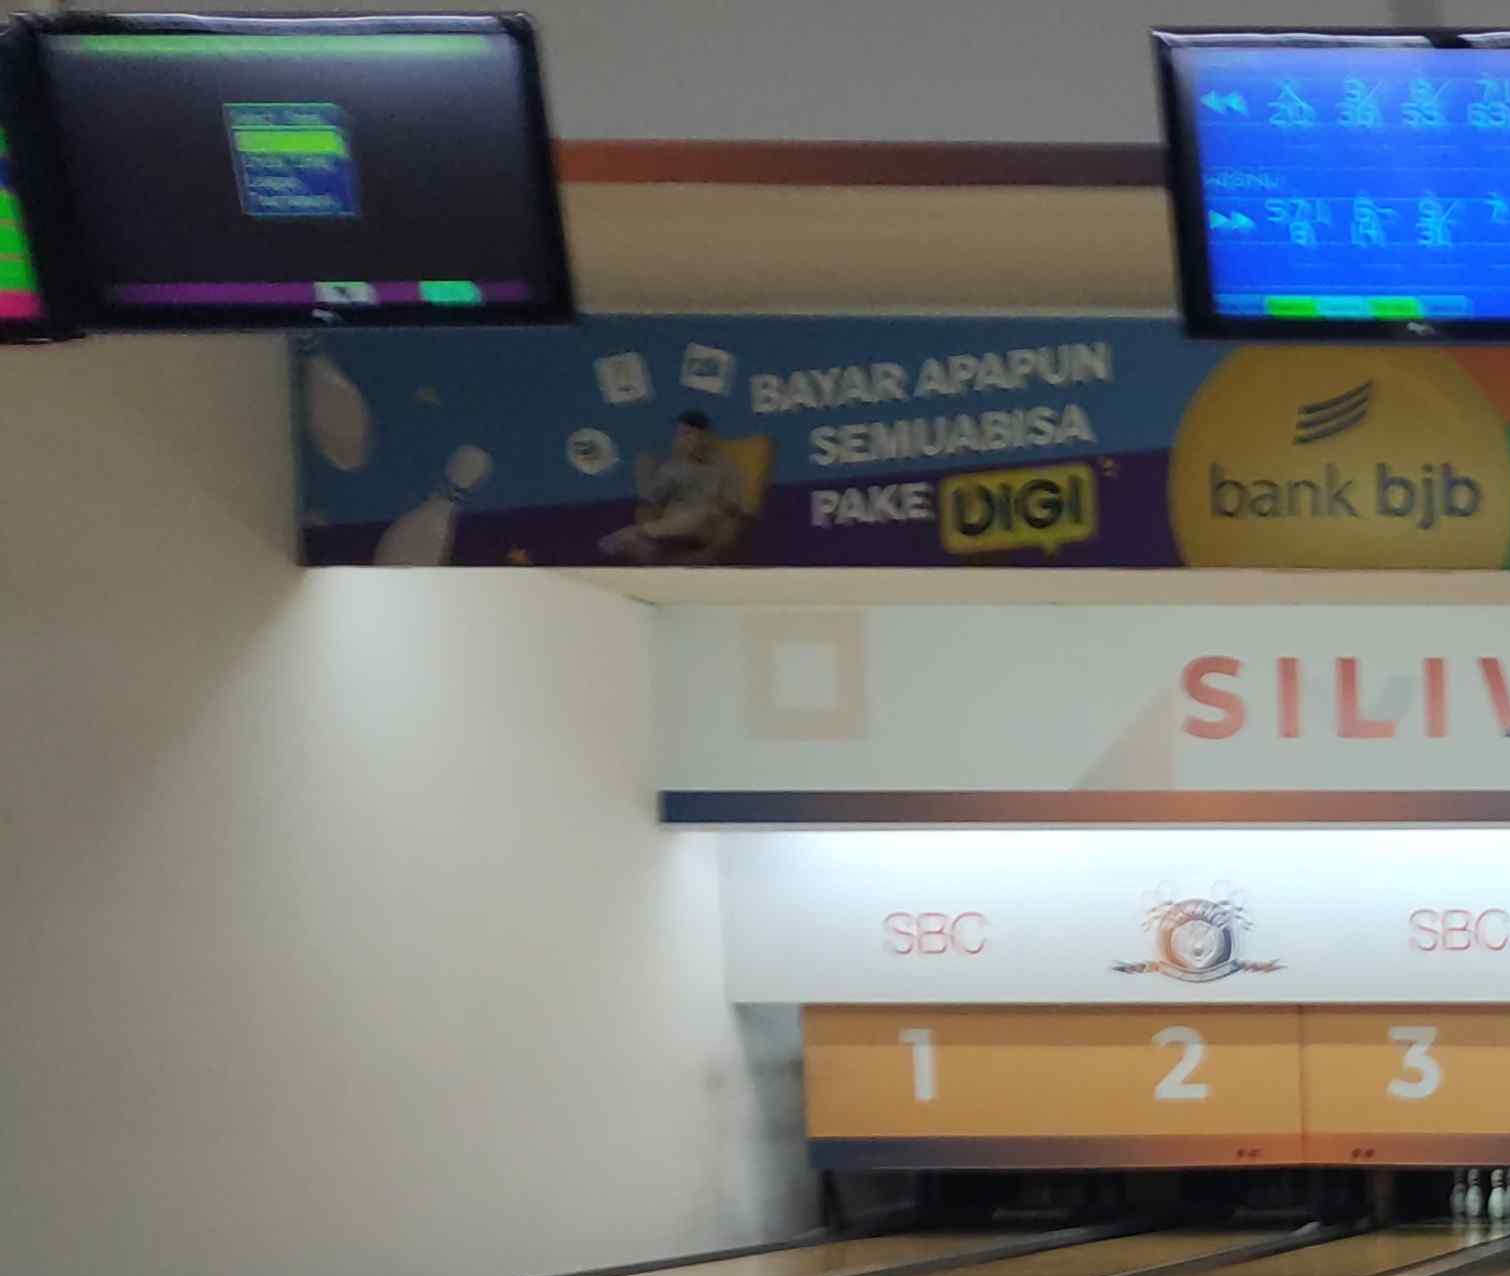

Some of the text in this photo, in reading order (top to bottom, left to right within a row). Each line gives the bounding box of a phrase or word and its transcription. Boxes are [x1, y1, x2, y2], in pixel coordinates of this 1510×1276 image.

[750, 342, 1114, 414] BAYAR APAPUN
[810, 474, 1084, 537] PAKE DIGI
[1208, 462, 1482, 530] bank bjb
[883, 911, 989, 956] SBC
[899, 1027, 937, 1101] 1
[1151, 1025, 1211, 1100] 2
[1387, 1026, 1442, 1099] 3
